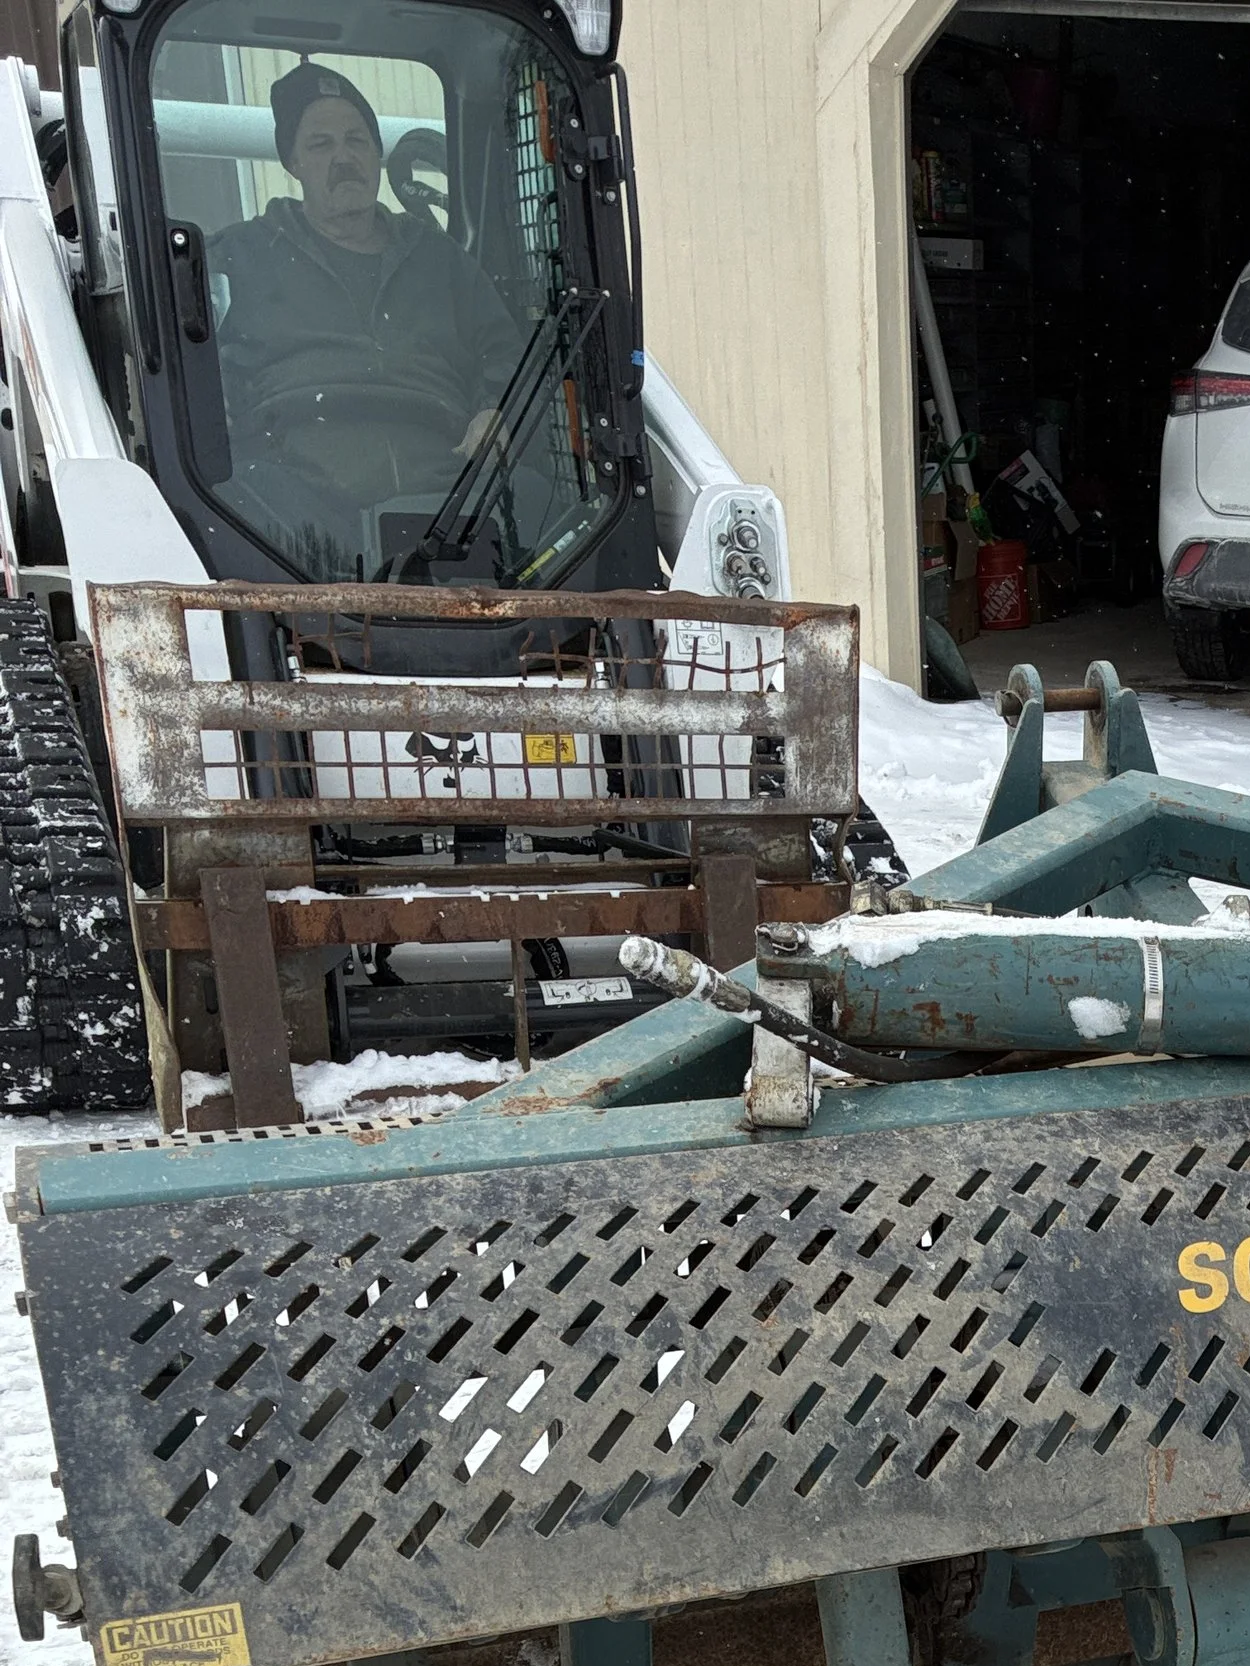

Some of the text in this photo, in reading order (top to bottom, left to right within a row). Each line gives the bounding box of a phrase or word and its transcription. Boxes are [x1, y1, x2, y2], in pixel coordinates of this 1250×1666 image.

[981, 575, 1016, 620] HOME
[111, 1610, 233, 1650] CAUTION
[121, 1651, 140, 1663] DO
